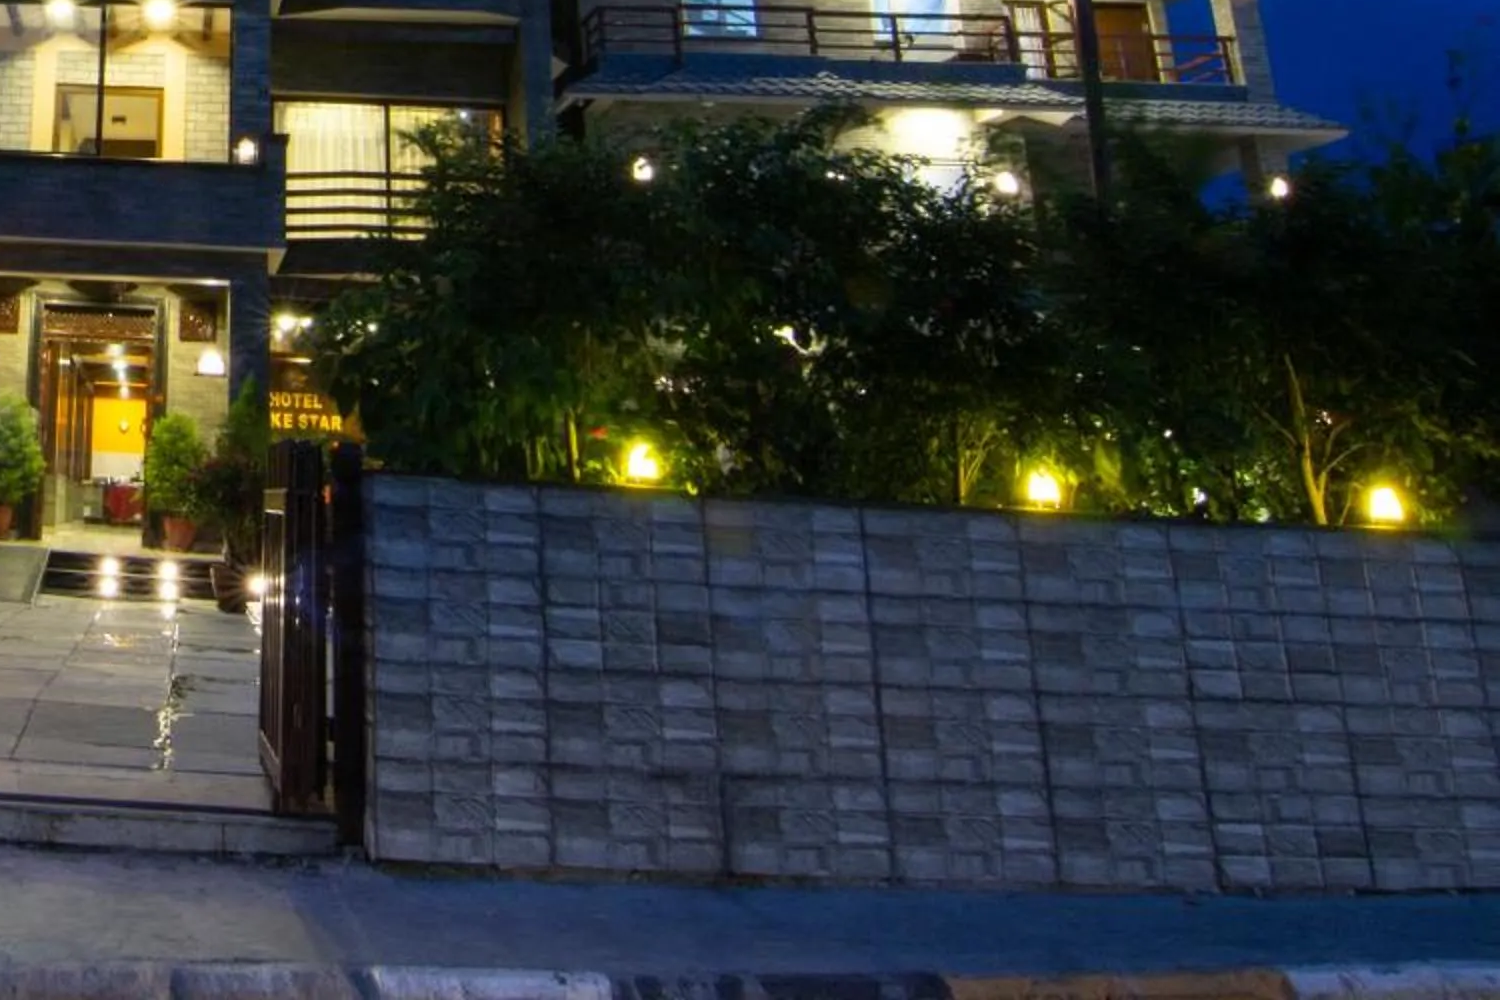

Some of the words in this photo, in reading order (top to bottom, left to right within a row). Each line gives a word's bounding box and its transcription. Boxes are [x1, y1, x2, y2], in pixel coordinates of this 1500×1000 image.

[269, 391, 323, 409] HOTEL
[269, 411, 293, 429] KE
[298, 412, 343, 431] STAR
